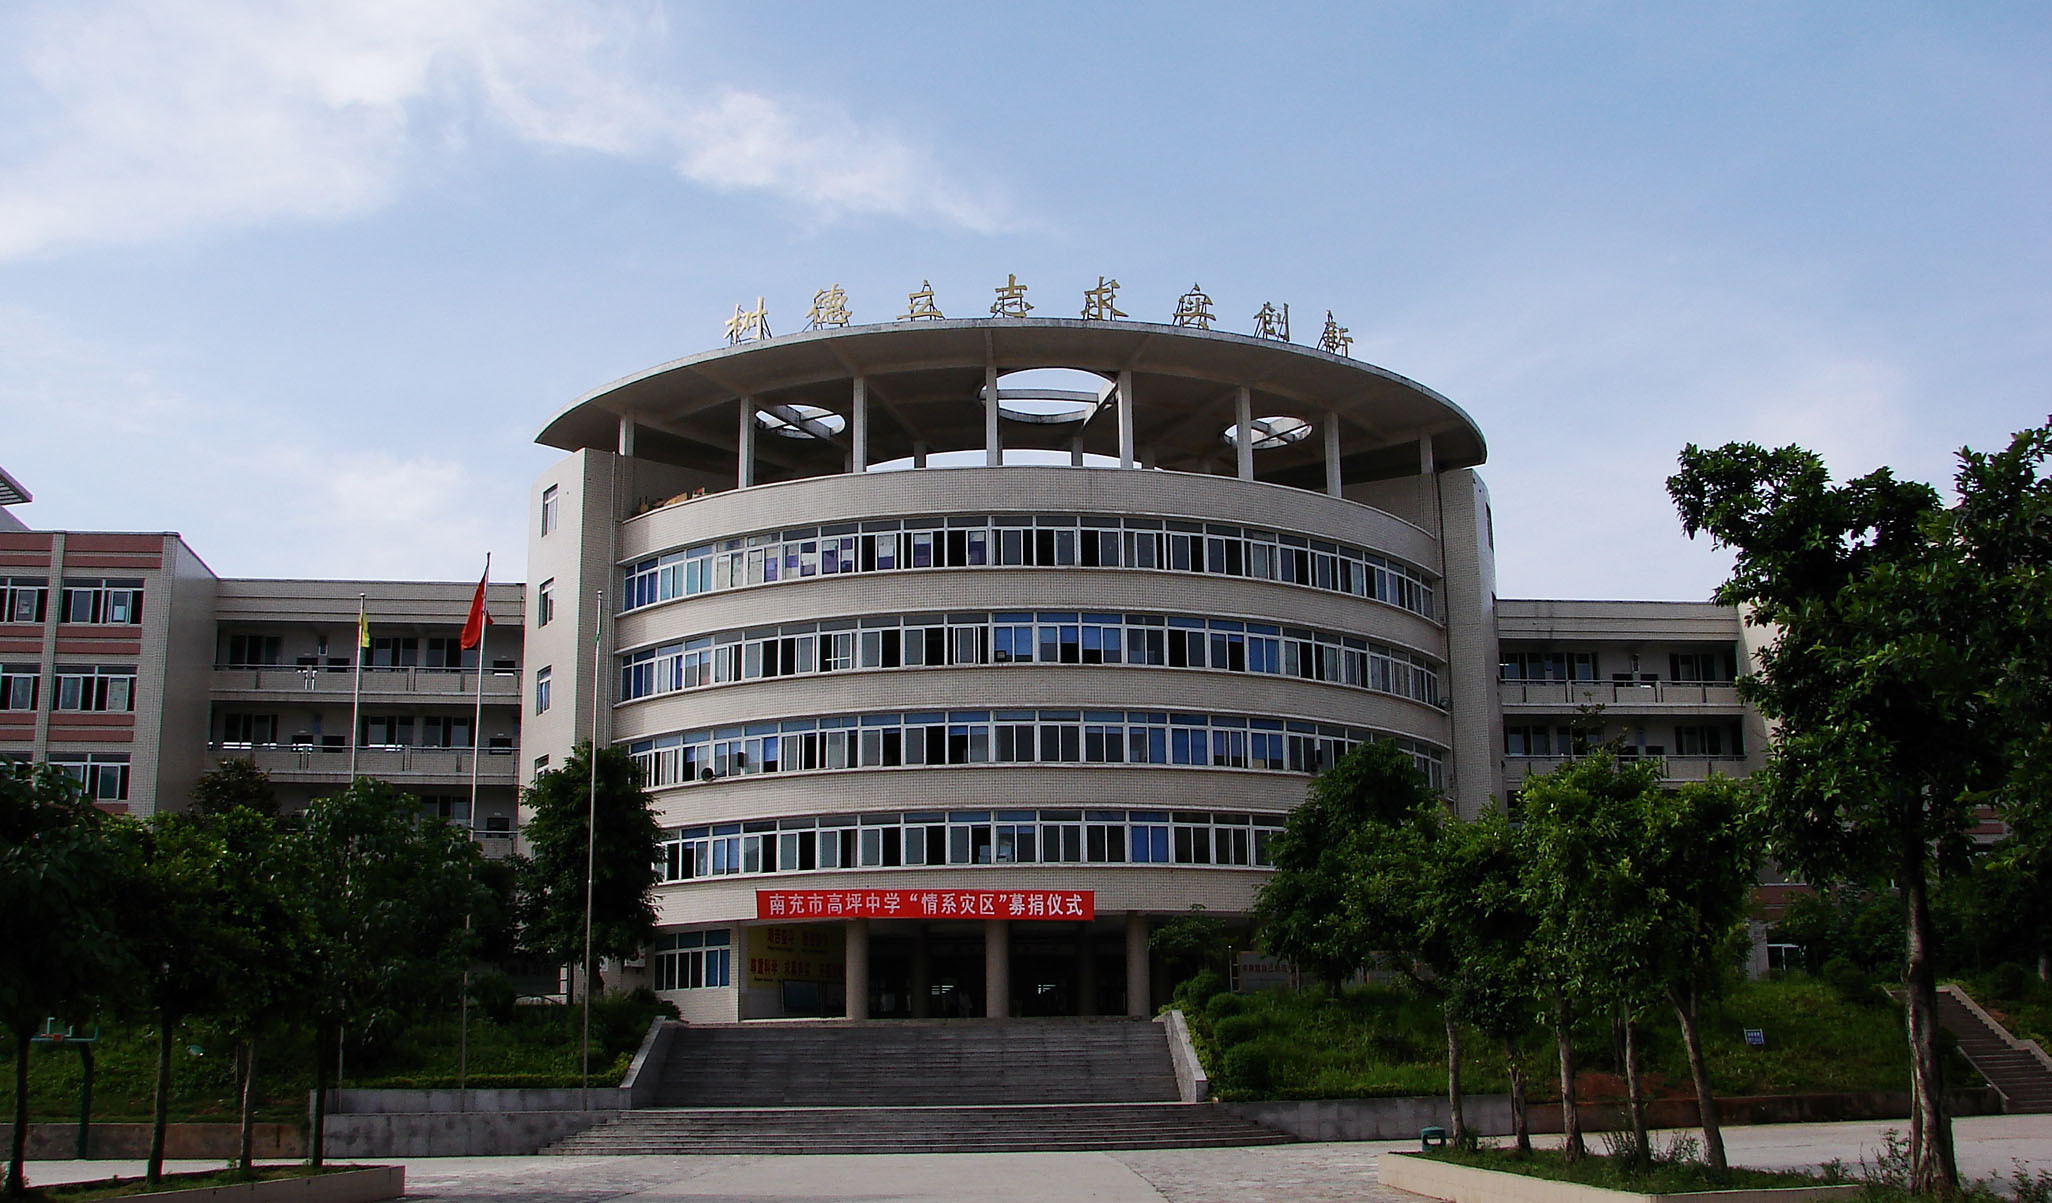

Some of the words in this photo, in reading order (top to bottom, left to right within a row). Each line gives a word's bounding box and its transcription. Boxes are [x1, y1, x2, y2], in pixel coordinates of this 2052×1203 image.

[769, 892, 1083, 916] 南充市高坪中学“情系灾区”募捐仪式
